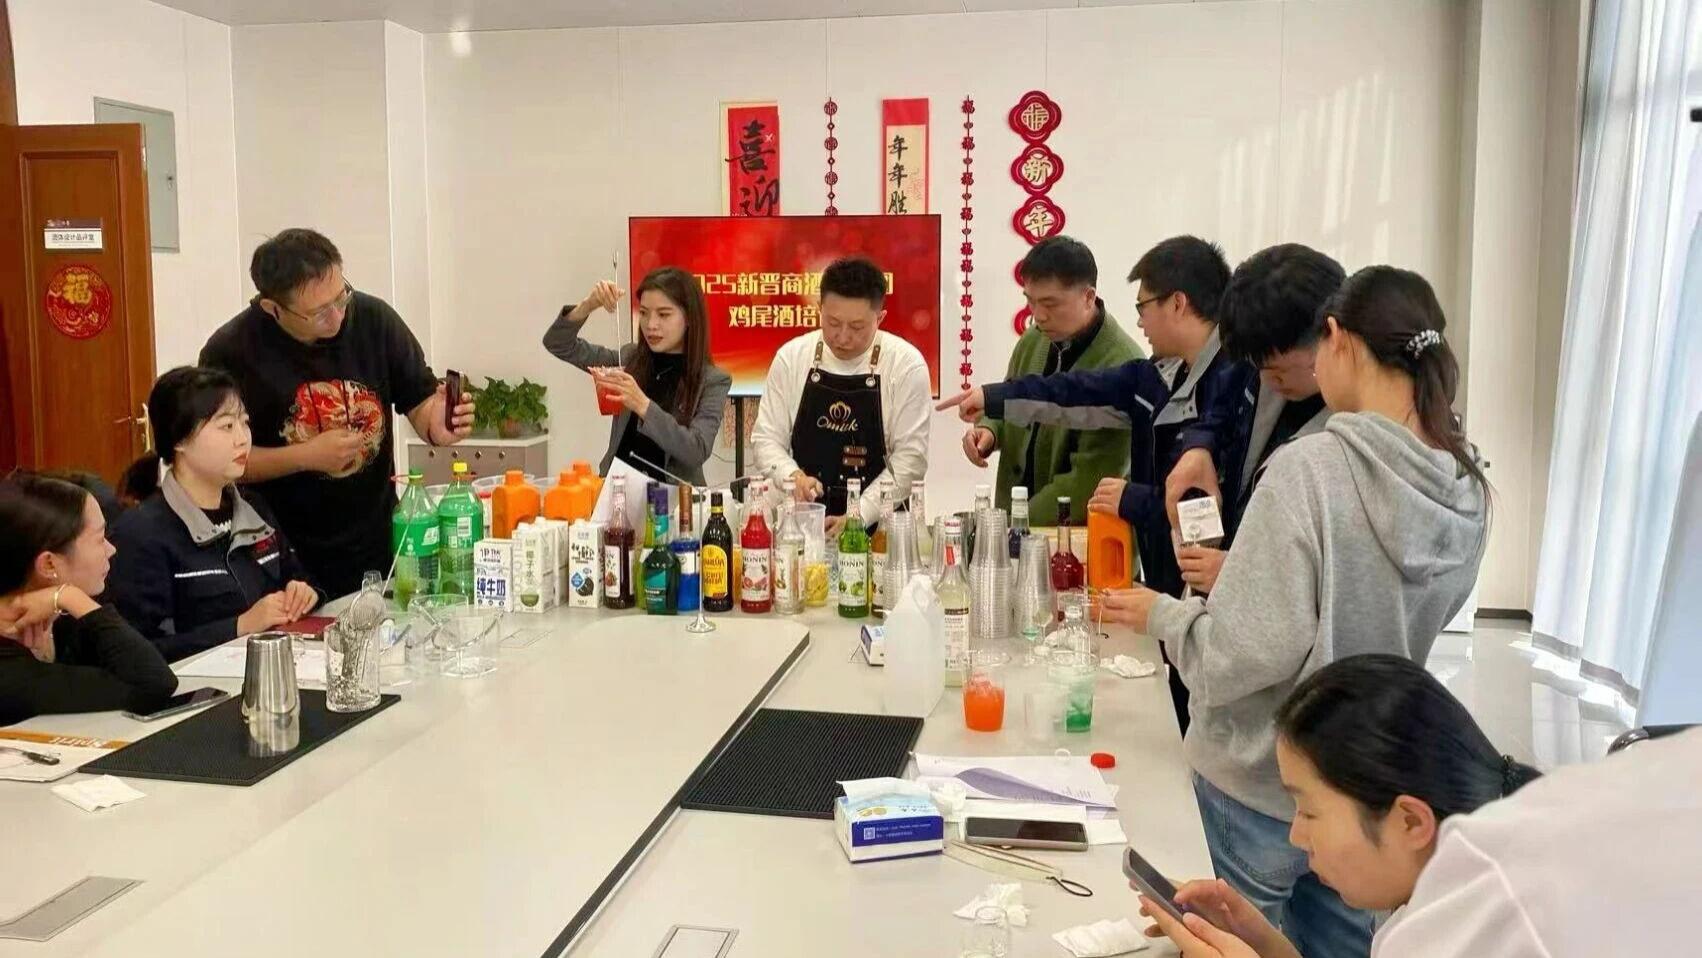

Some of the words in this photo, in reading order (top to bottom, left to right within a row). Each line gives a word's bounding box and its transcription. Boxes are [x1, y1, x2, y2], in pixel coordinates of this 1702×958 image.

[63, 273, 93, 304] 福
[476, 577, 506, 597] 纯牛奶
